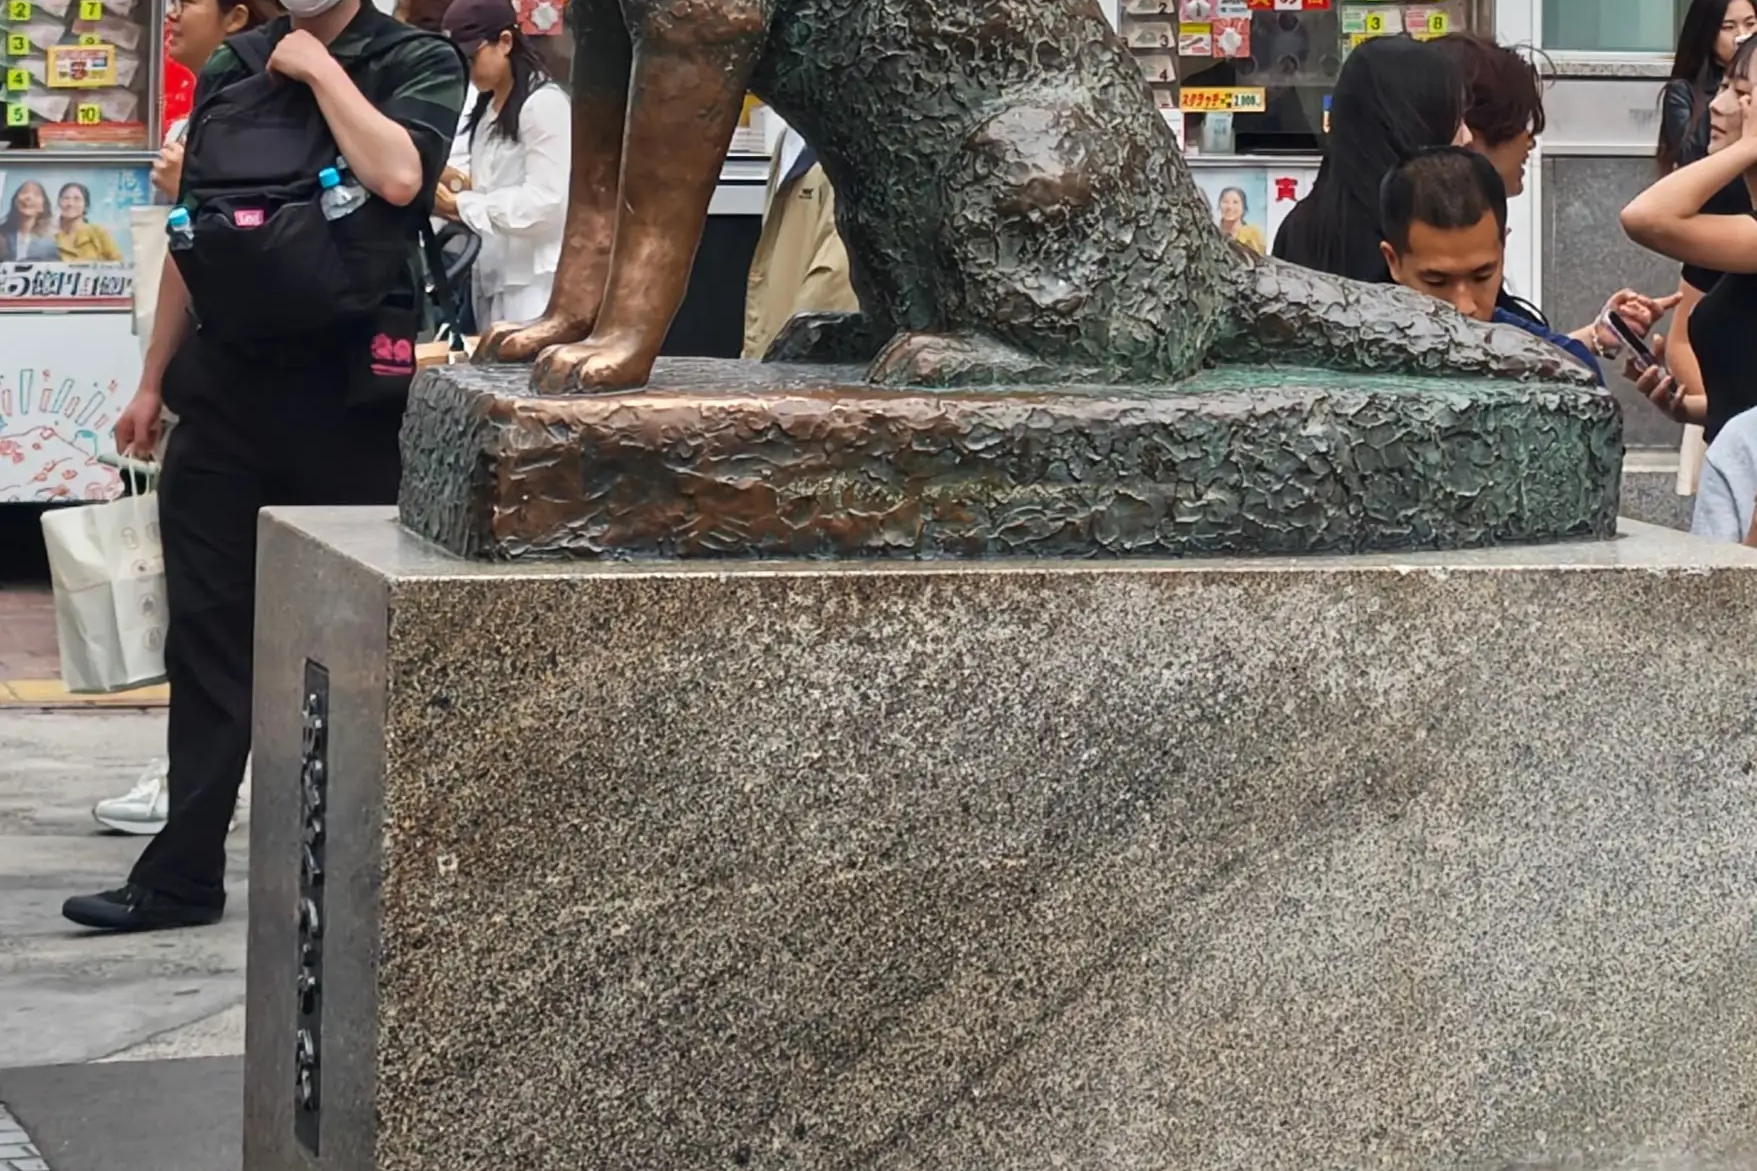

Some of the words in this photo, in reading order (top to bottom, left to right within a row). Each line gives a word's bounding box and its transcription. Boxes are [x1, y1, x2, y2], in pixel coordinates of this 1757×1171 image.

[15, 3, 25, 18] 2
[87, 2, 95, 16] 7
[1371, 16, 1380, 30] 3
[1433, 16, 1442, 30] 8
[13, 36, 23, 50] 3
[1159, 34, 1168, 47] 3
[12, 71, 23, 85] 4
[1159, 68, 1168, 82] 4
[14, 108, 23, 121] 5
[80, 107, 95, 120] 10
